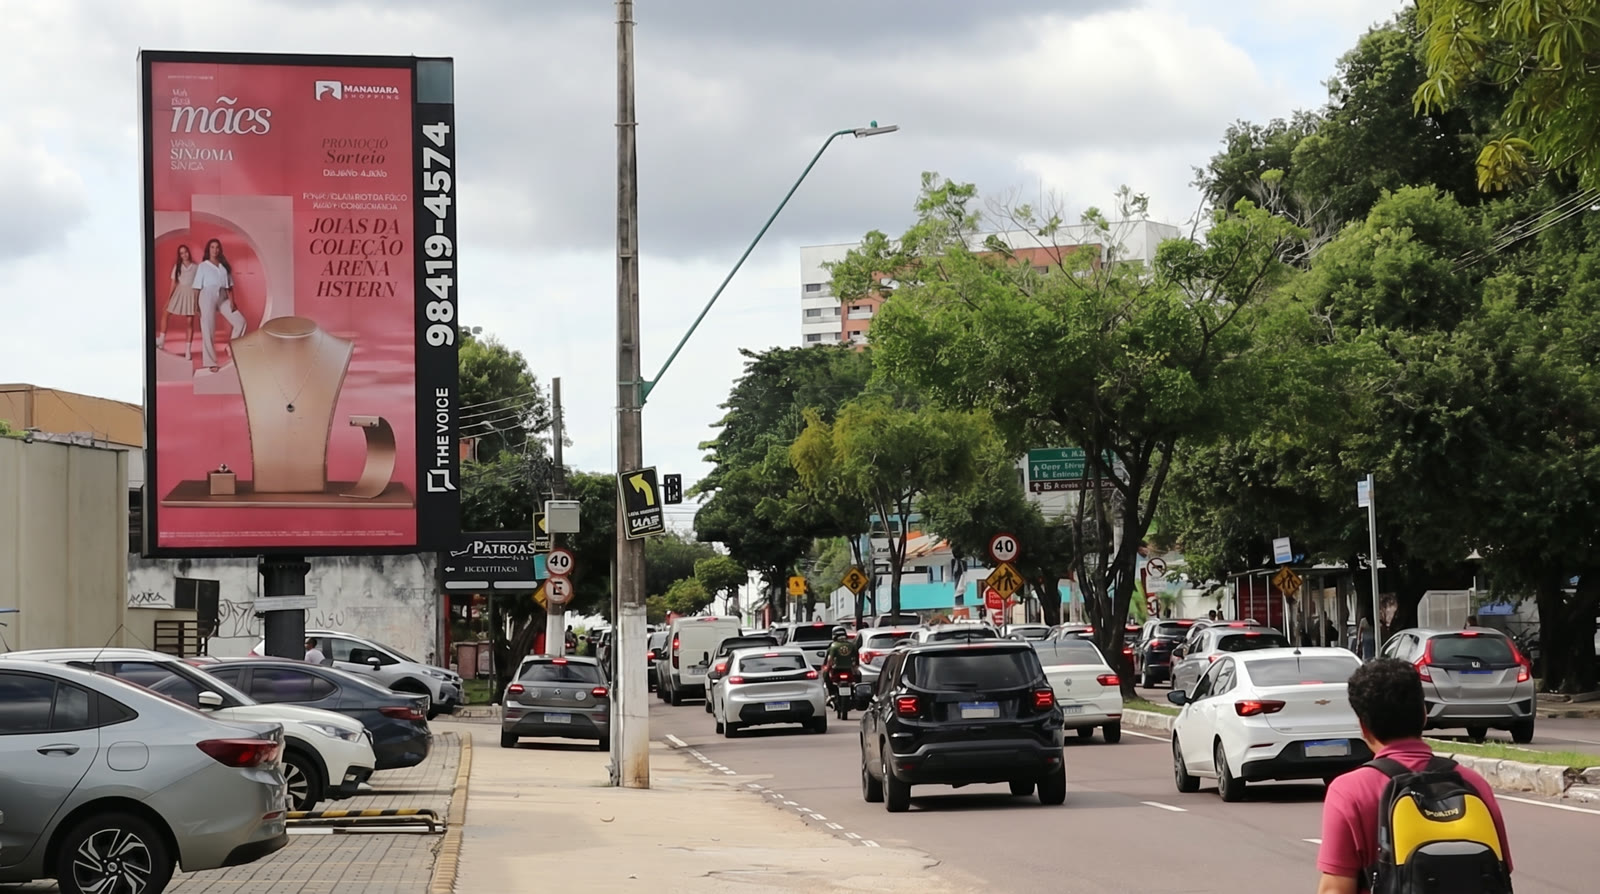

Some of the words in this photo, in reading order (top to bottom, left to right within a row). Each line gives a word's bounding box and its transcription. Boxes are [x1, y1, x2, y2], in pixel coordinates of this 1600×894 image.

[344, 85, 399, 94] MANAUARA
[324, 149, 386, 165] Sorteio
[309, 217, 368, 235] JOIAS
[372, 218, 400, 235] DA
[422, 122, 455, 347] 98419-4574
[309, 236, 404, 259] COLEÇÃO
[320, 259, 390, 277] ARENA
[436, 387, 449, 433] VOICE
[437, 435, 450, 467] THE
[995, 539, 1014, 553] 40
[550, 554, 569, 567] 40
[553, 581, 563, 595] E
